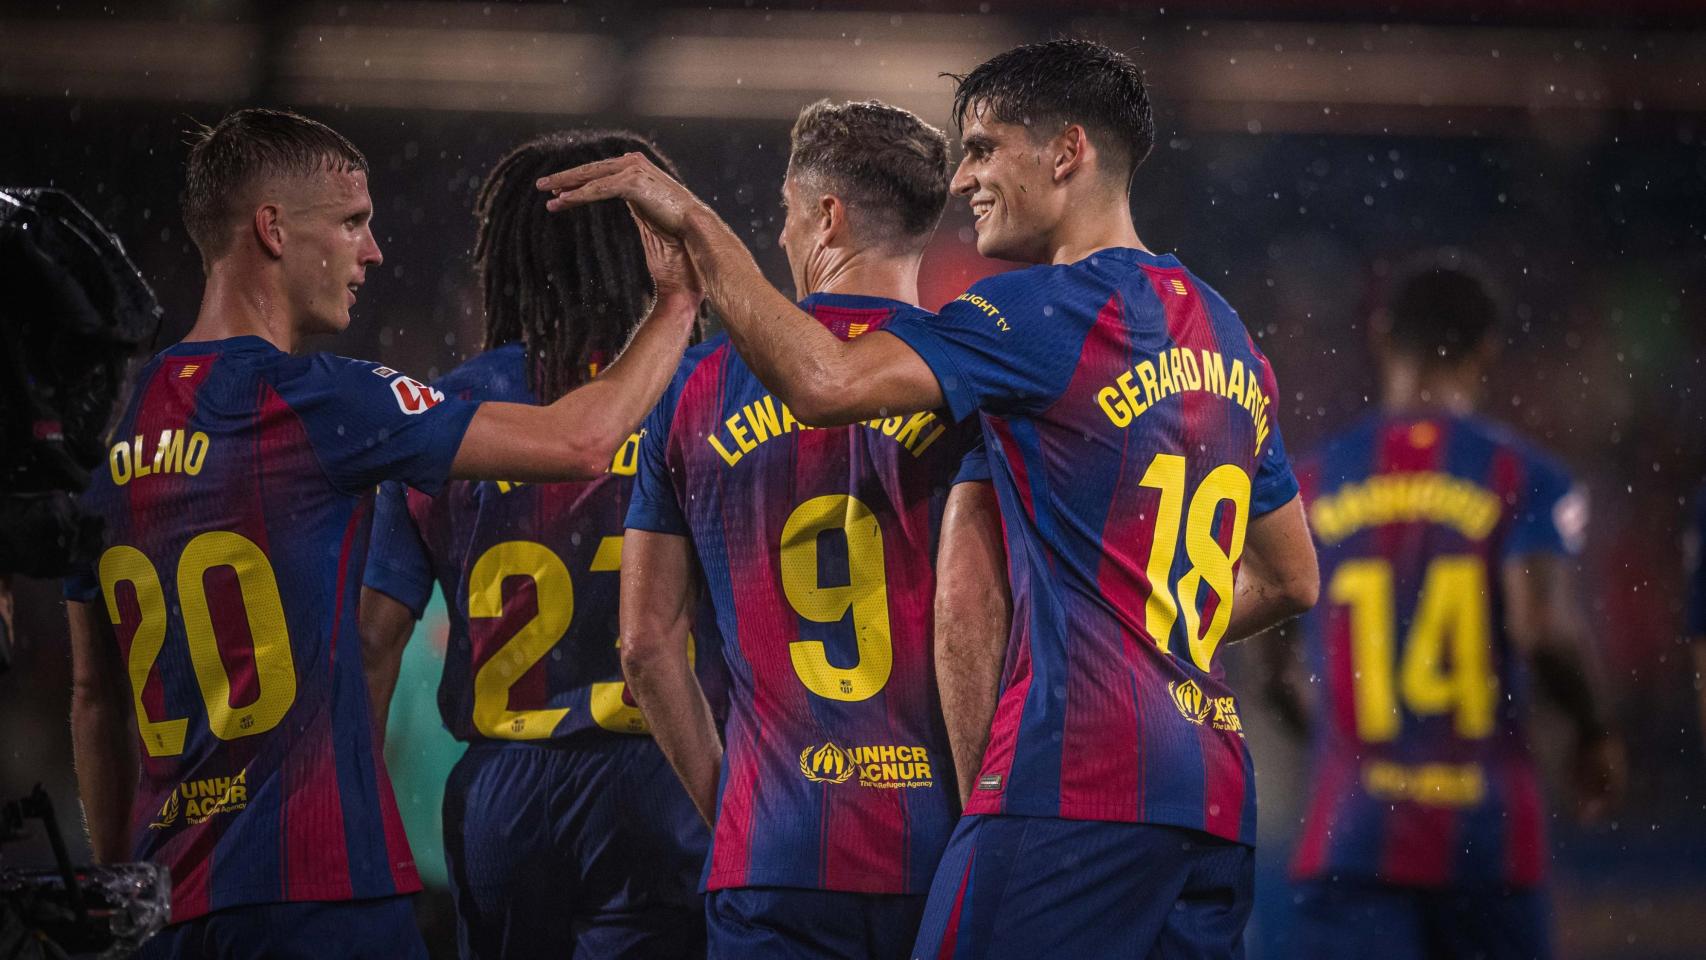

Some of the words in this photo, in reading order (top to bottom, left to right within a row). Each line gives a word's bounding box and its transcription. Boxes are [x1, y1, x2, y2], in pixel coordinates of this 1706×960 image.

[997, 318, 1010, 331] tv
[1098, 347, 1202, 428] GERARD
[109, 429, 210, 486] OLMO
[707, 395, 946, 467] LEWASKI
[780, 494, 893, 702] 9
[1138, 453, 1252, 673] 18
[99, 531, 297, 757] 20
[1330, 555, 1496, 743] 14
[847, 745, 929, 764] UNHCR
